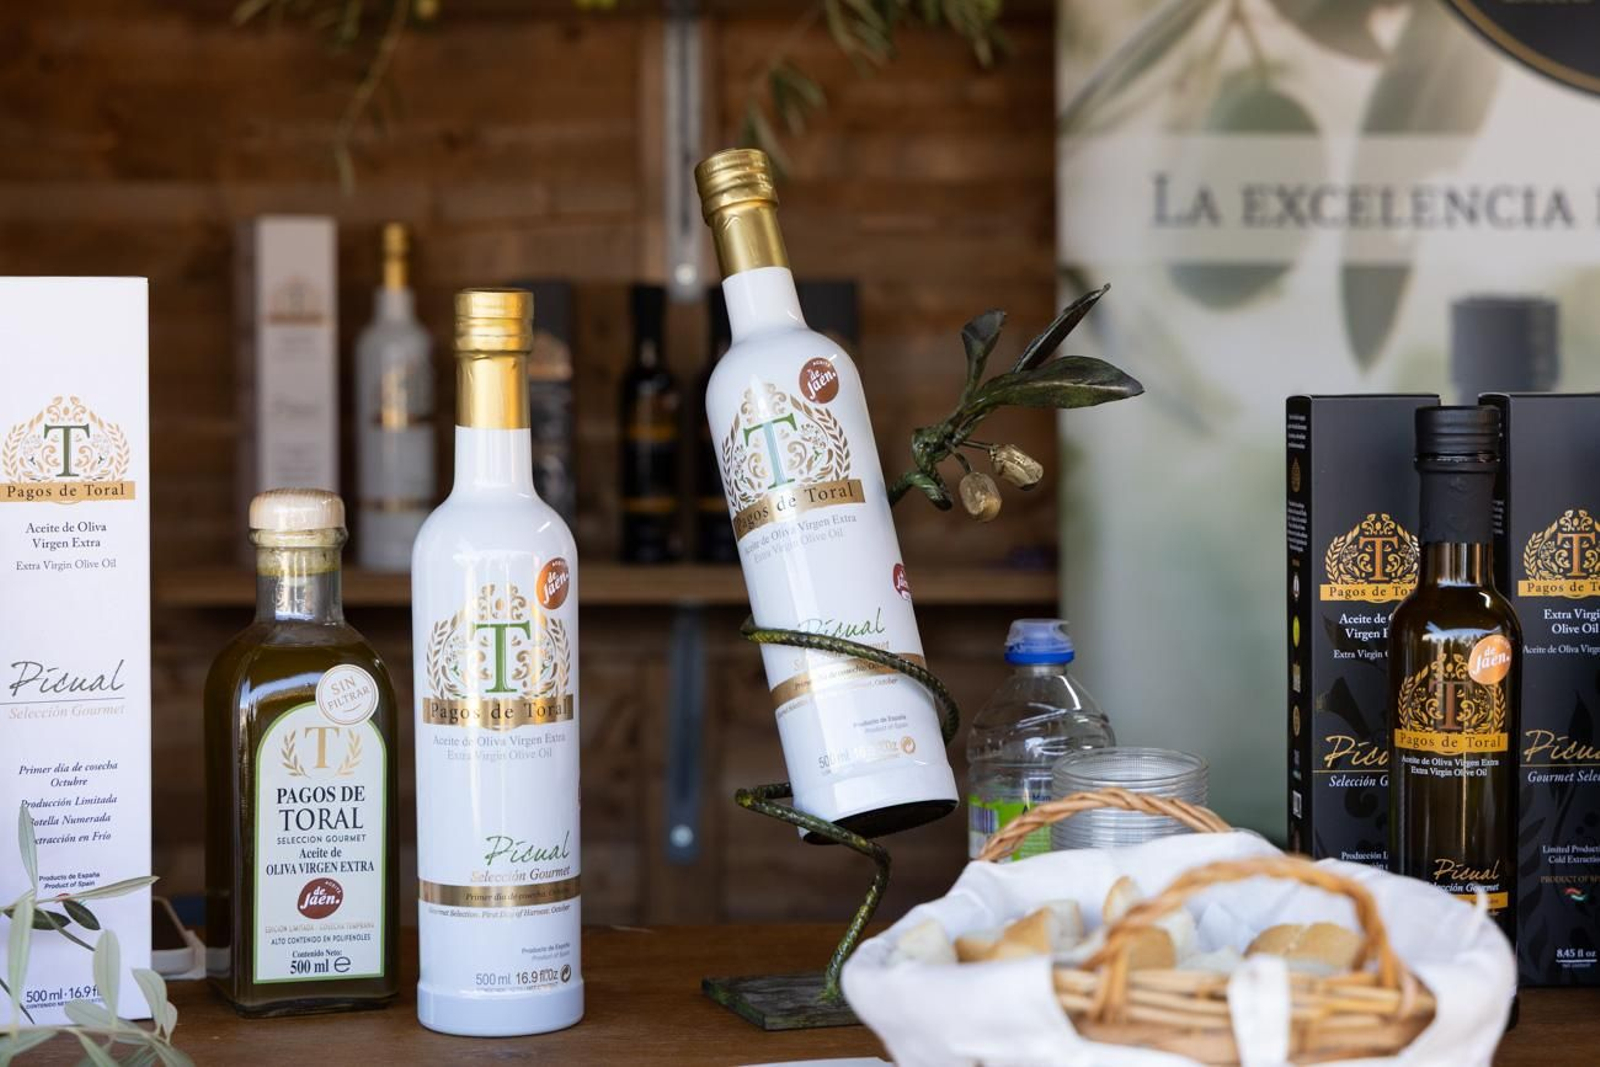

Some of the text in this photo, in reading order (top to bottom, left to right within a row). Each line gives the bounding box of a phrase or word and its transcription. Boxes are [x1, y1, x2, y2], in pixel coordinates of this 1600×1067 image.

[1241, 182, 1575, 229] EXCELENCIA
[44, 424, 90, 477] T
[743, 413, 798, 490] T
[7, 483, 125, 500] Pagos de Toral
[776, 496, 796, 512] de
[804, 482, 854, 503] Toral
[25, 521, 107, 534] Aceite de Oliva
[797, 517, 830, 531] Virgen
[832, 513, 857, 525] Extra
[32, 537, 101, 551] Virgen Extra
[1359, 536, 1398, 581] T
[1557, 532, 1595, 576] T
[16, 558, 117, 572] Extra Virgin Olive Oil
[1329, 586, 1387, 600] Pagos de
[1527, 582, 1563, 595] Pagos
[1569, 581, 1584, 592] de
[1339, 613, 1372, 624] Aceite
[1374, 613, 1387, 624] de
[1543, 608, 1600, 622] Extra Virgi
[1345, 628, 1380, 641] Virgen
[1551, 622, 1599, 634] Olive Oil
[470, 620, 530, 693] T
[1333, 649, 1355, 659] Extra
[1357, 650, 1383, 661] Virgin
[1547, 645, 1557, 654] de
[330, 675, 356, 696] SIN
[327, 686, 371, 710] FILTRAR
[9, 704, 125, 720] Selección Gourmet
[431, 700, 568, 724] Pagos de Toral
[509, 735, 542, 747] Virgen
[545, 732, 565, 744] Extra
[1400, 733, 1501, 748] Pagos de Toral
[304, 726, 340, 769] T
[19, 760, 118, 775] Primer día de cosecha
[50, 777, 88, 788] Octubre
[1329, 774, 1376, 788] Selección
[1528, 770, 1574, 783] Gourmet
[75, 794, 118, 806] Limitada
[276, 785, 365, 804] PAGOS DE
[62, 812, 111, 825] Numerada
[279, 806, 364, 832] TORAL
[78, 830, 111, 843] en Frío
[276, 834, 366, 845] SELECCION GOURMET
[299, 846, 342, 859] Aceite de
[1341, 851, 1382, 861] Producción
[266, 860, 374, 876] OLIVA VIRGEN EXTRA
[529, 865, 571, 882] Gourmet
[38, 873, 67, 882] Producto
[77, 880, 96, 888] Spain
[313, 886, 326, 896] de
[270, 937, 286, 945] ALTO
[288, 935, 321, 944] CONTENIDO
[333, 933, 371, 942] POLIFENOLES
[292, 948, 342, 958] Contenido Neto:
[290, 958, 329, 975] 500 ml
[475, 970, 539, 985] 500 ml 16.9
[26, 985, 91, 1003] 500 ml 16.9
